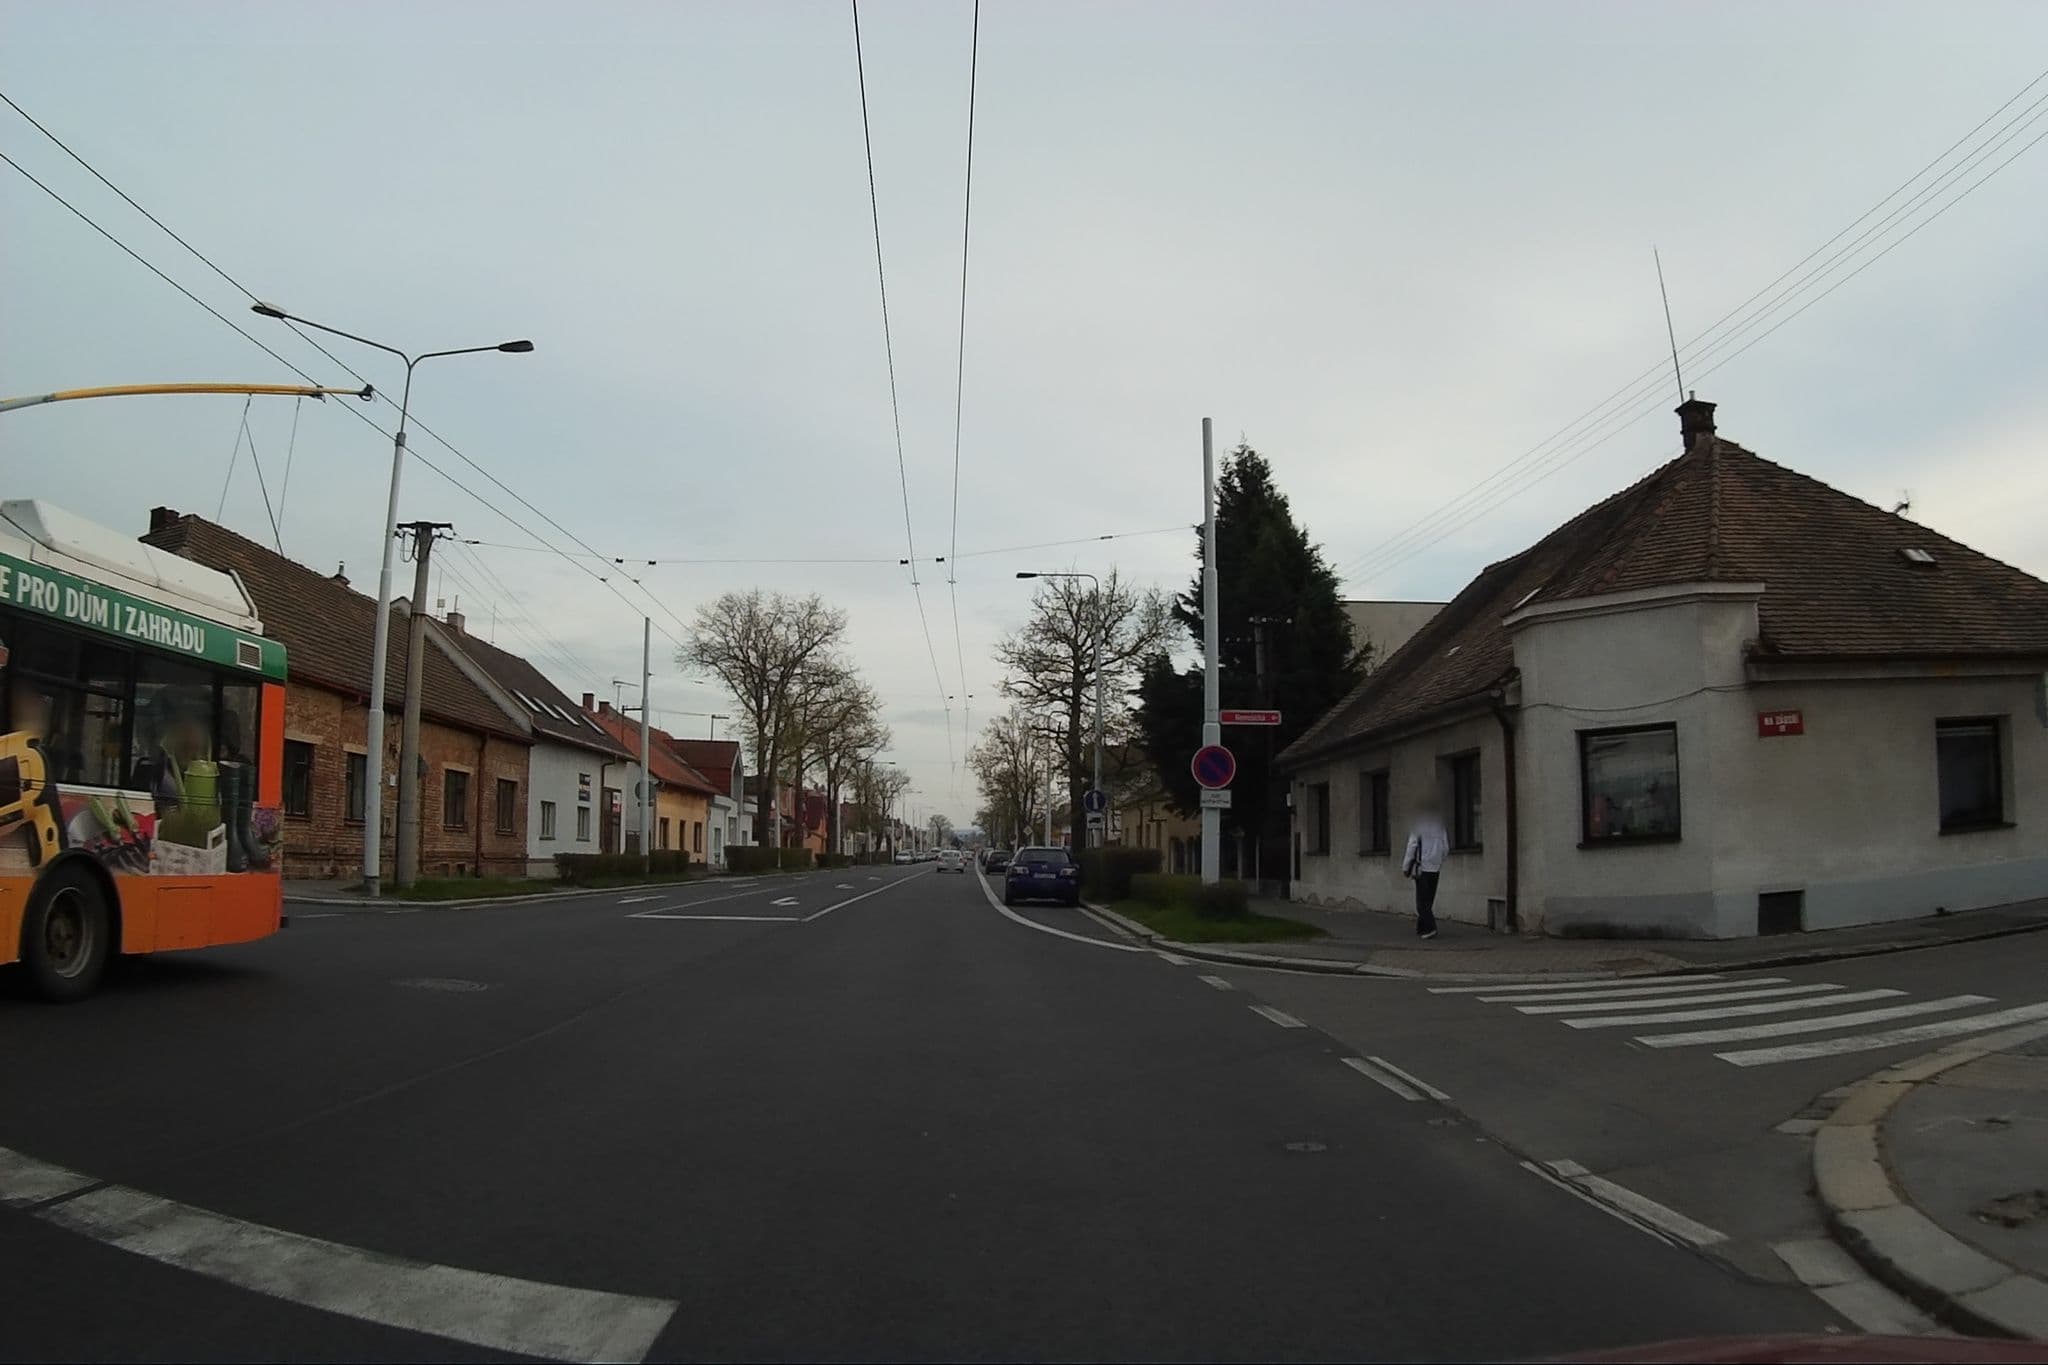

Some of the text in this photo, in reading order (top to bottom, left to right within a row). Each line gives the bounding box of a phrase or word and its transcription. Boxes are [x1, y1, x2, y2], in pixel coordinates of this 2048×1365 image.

[16, 571, 60, 612] PRO
[65, 584, 108, 627] DŮM
[114, 602, 120, 631] I
[125, 606, 205, 653] ZAHRADU
